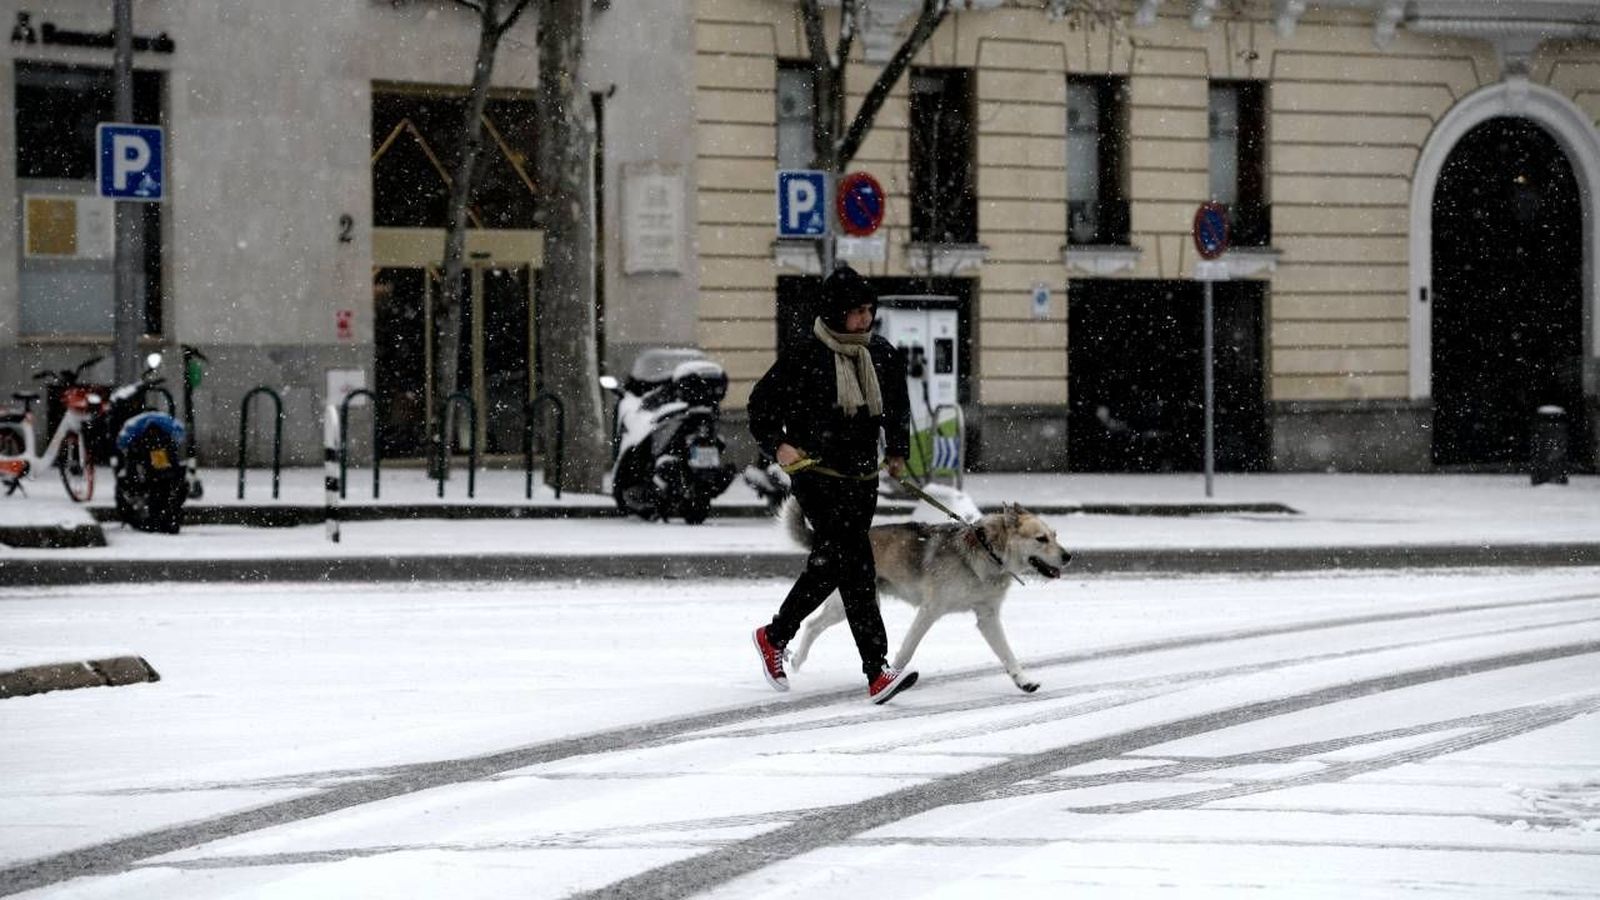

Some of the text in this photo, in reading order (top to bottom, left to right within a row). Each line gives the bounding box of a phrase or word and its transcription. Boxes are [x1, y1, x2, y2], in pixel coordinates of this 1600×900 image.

[113, 134, 151, 190] P
[339, 214, 353, 243] 2
[788, 179, 816, 229] P
